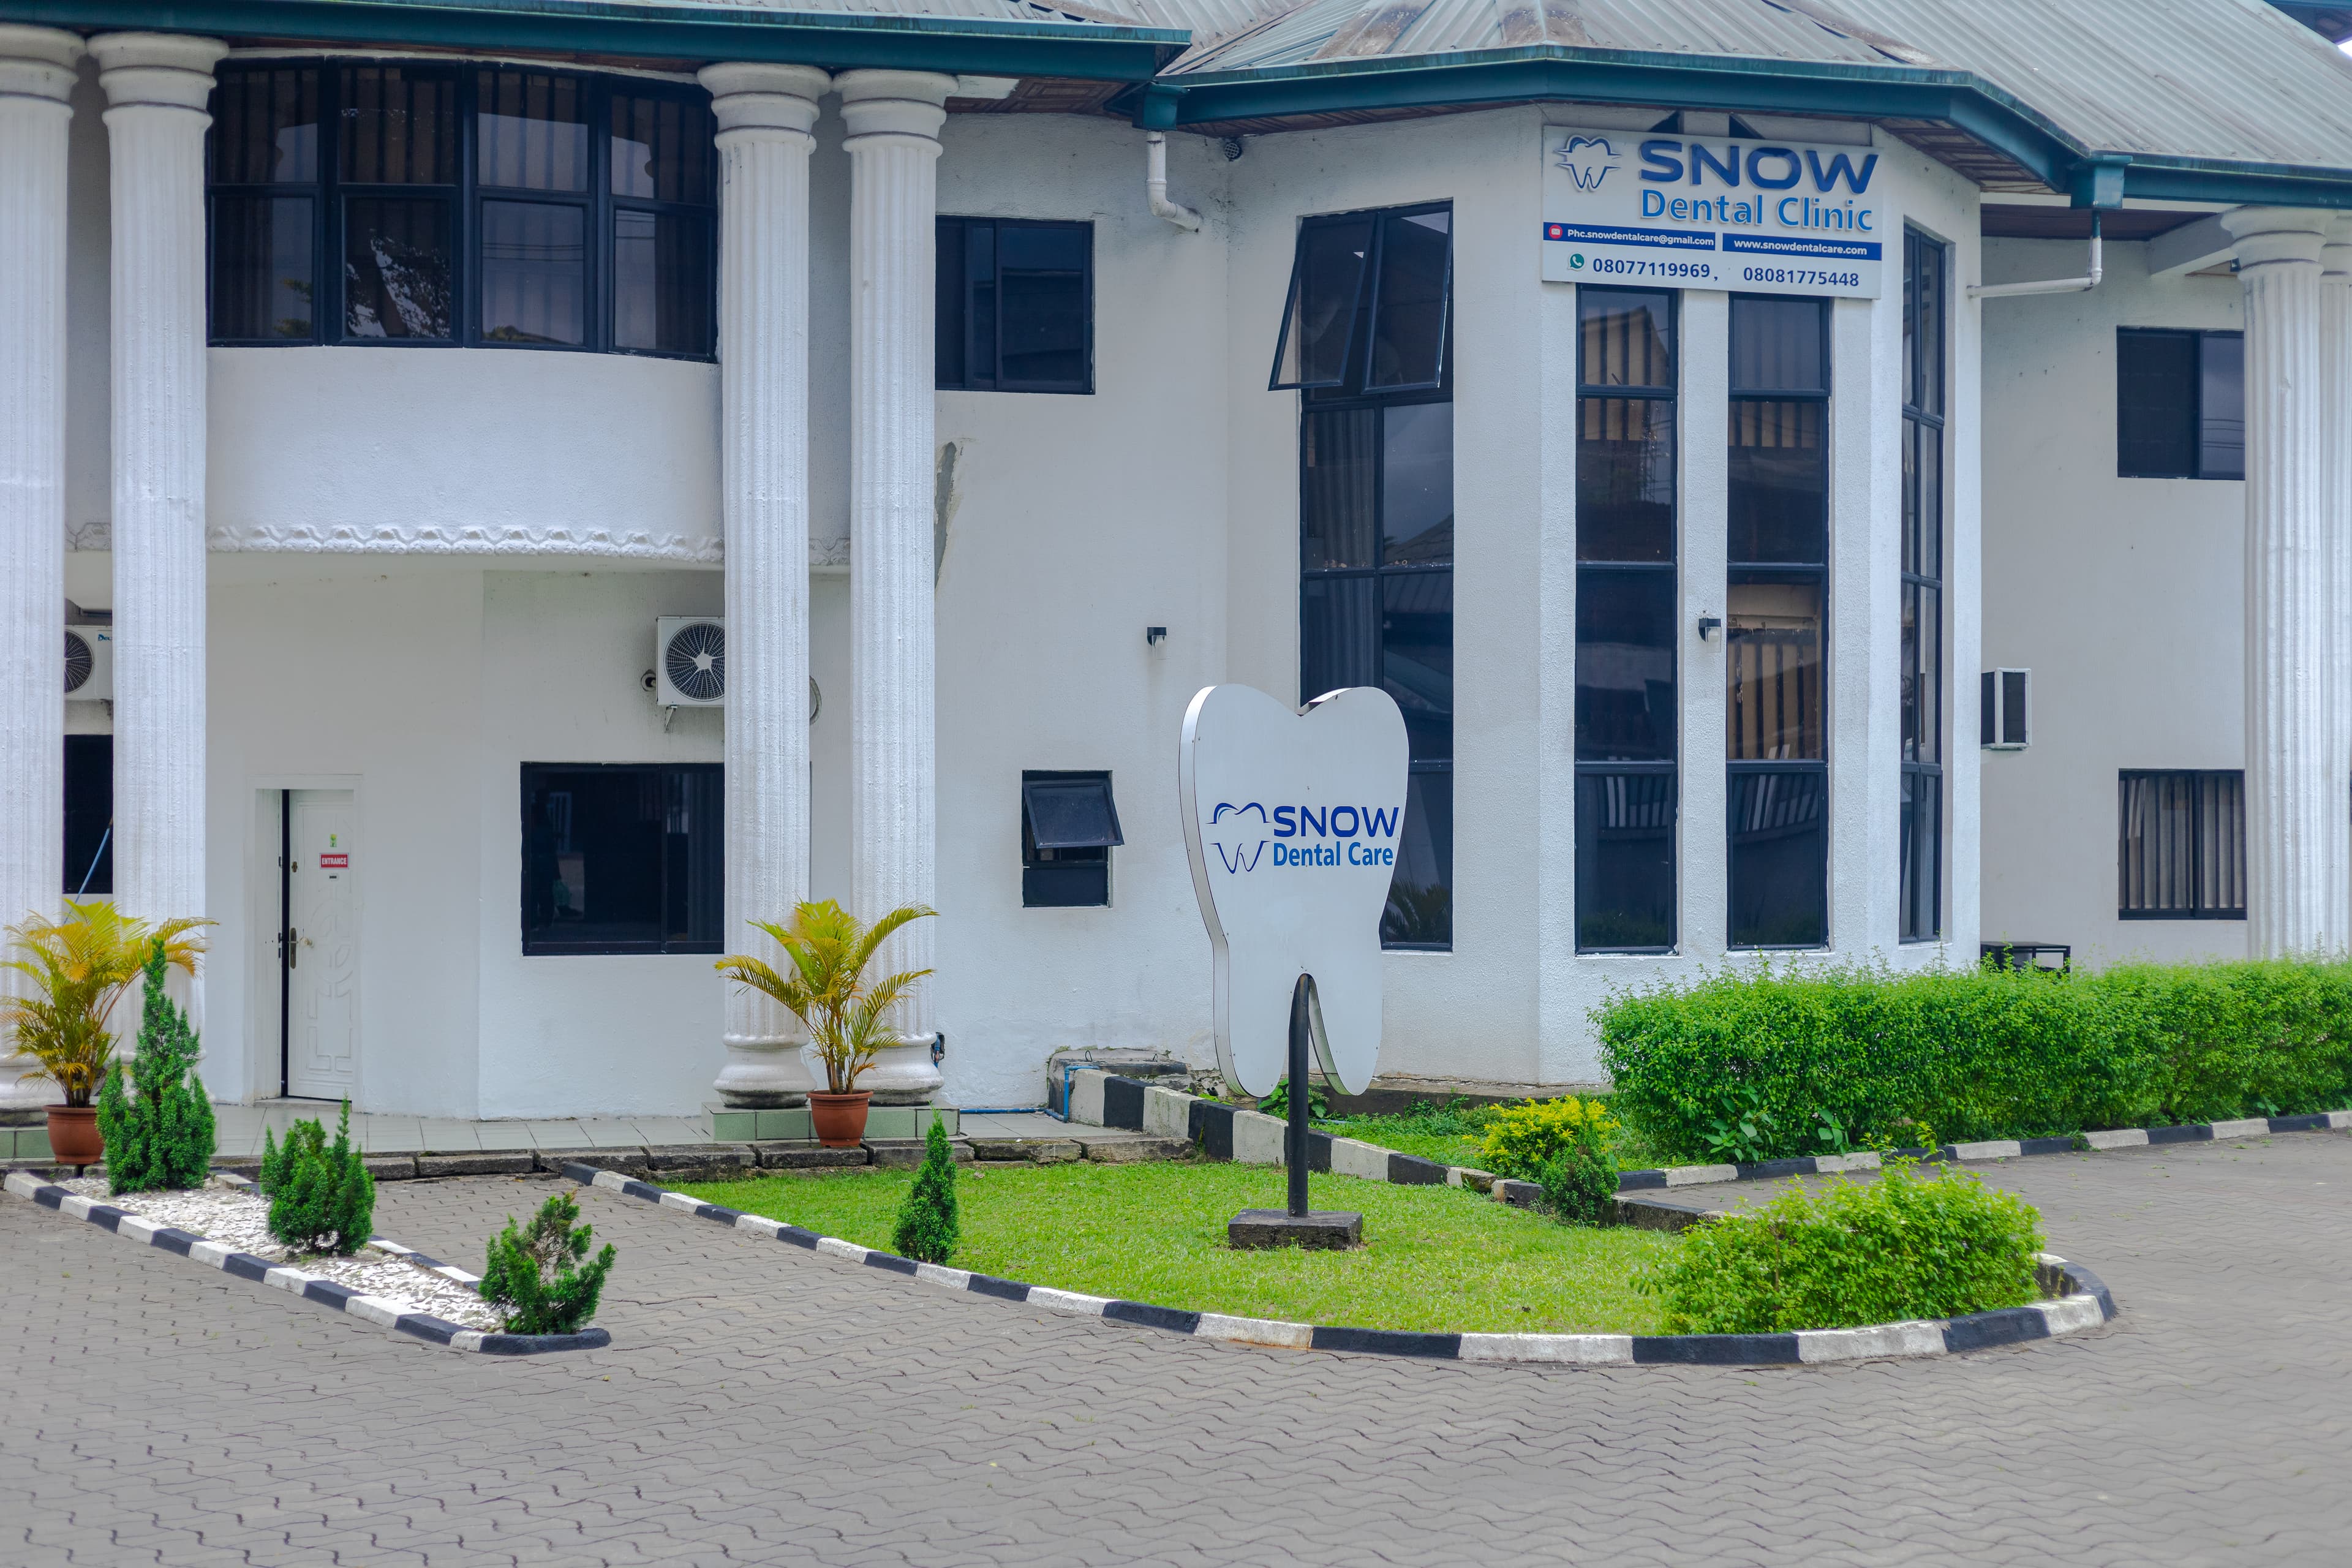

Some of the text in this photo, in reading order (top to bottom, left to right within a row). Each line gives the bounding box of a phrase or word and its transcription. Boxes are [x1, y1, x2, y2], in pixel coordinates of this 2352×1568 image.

[1639, 140, 1879, 194] SNOW
[1641, 189, 1874, 232] Dental Clinic
[1567, 228, 1714, 246] Phc.snowdentalcare@gmail.com
[1733, 239, 1868, 255] www.snowdentalcare.com
[1743, 266, 1860, 287] 08081775448
[1273, 805, 1400, 838] SNOW
[1273, 842, 1393, 866] Dental Care
